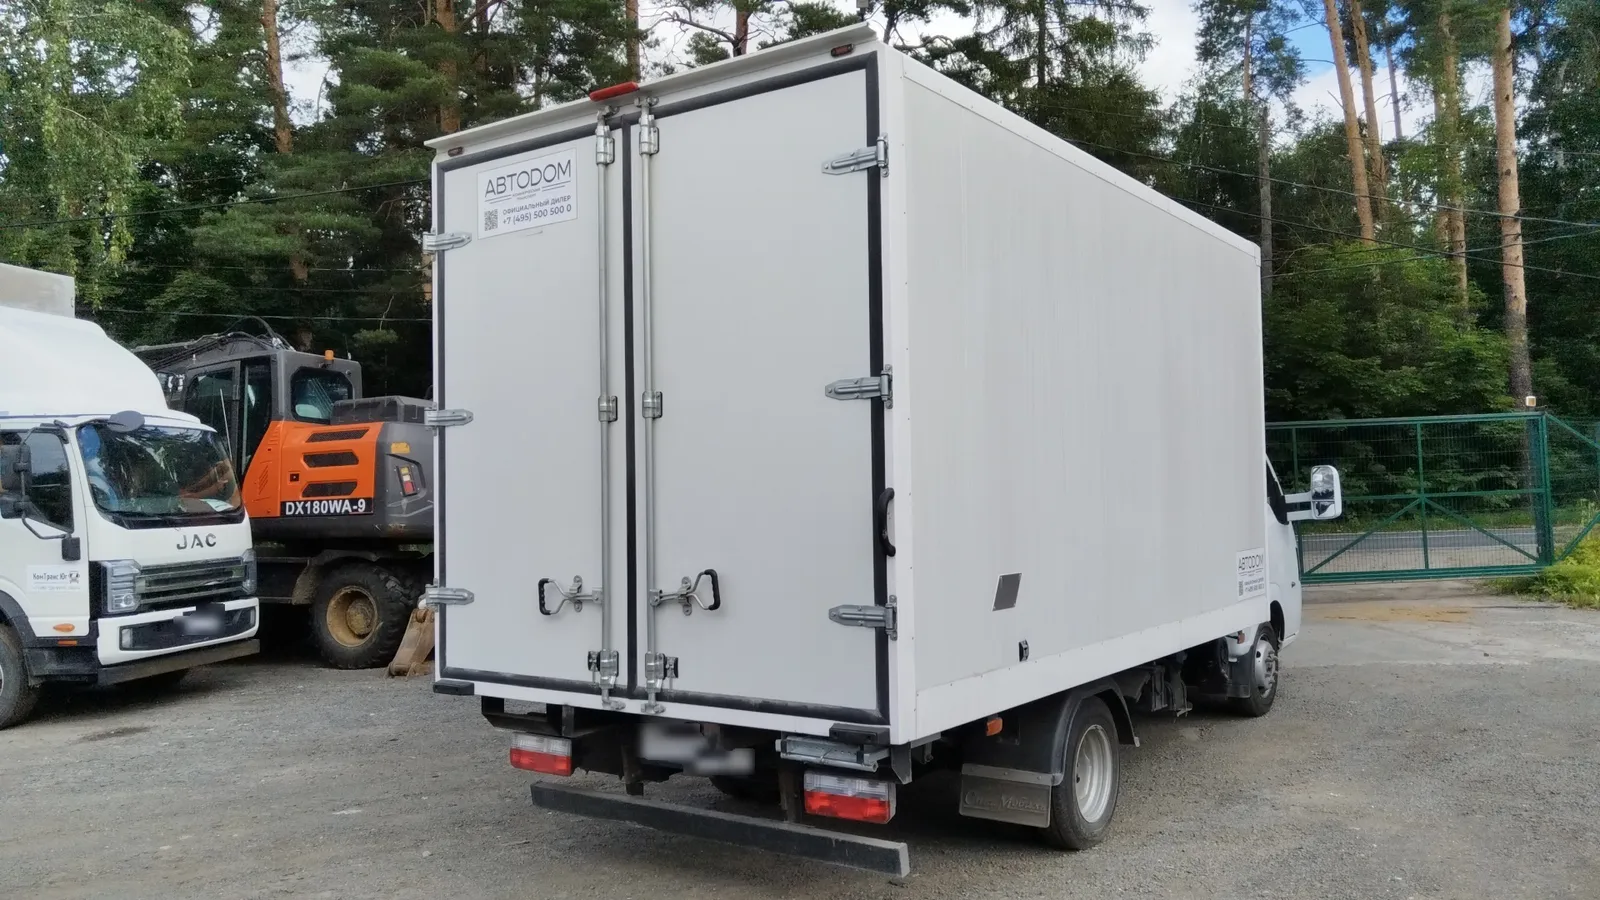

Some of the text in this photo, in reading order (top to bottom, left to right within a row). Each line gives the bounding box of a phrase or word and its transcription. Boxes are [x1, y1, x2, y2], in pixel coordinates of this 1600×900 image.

[502, 199, 550, 216] ОФИЦИАЛЬНЫЙ
[550, 194, 571, 206] ДИЛЕР
[503, 203, 572, 225] +7 (495) 500 500 0
[285, 499, 366, 516] DX180WA-9
[176, 533, 217, 550] JAC
